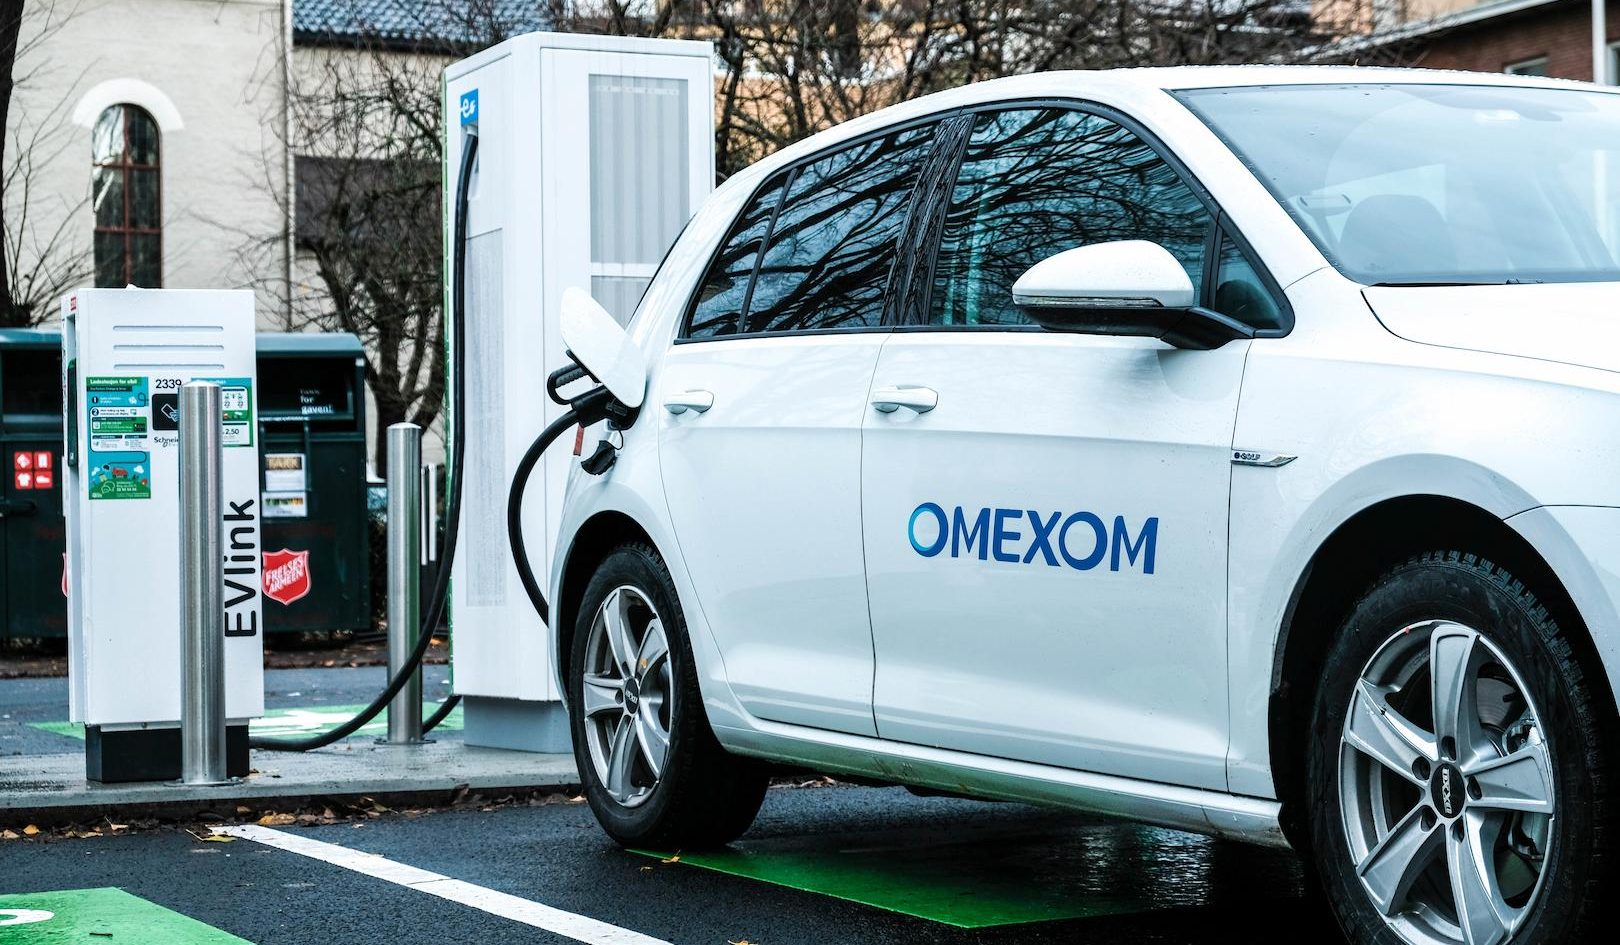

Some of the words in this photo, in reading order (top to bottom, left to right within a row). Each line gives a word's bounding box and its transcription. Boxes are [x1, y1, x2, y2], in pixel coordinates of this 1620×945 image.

[155, 379, 182, 389] 2339
[300, 393, 314, 403] for
[908, 501, 1159, 575] OMEXOM
[224, 499, 256, 638] EVlink
